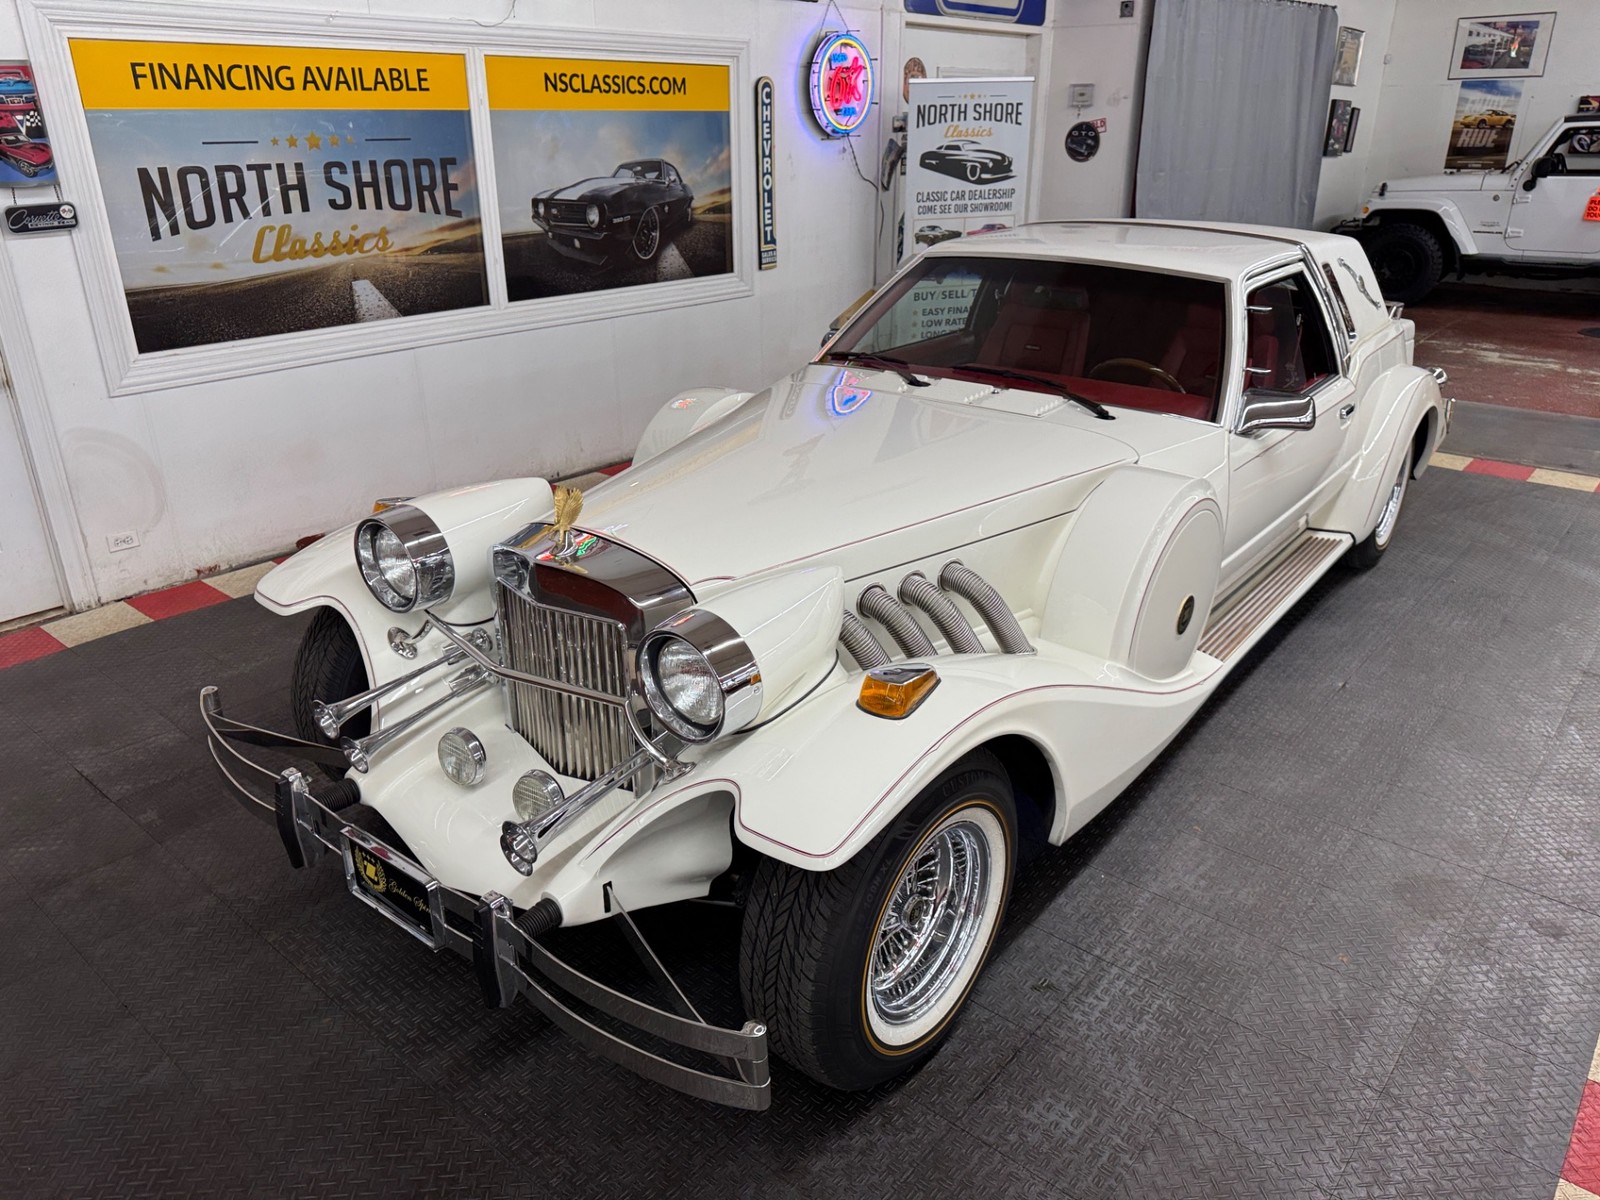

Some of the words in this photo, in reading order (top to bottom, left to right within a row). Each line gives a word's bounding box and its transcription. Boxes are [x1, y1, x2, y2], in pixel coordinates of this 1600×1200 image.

[130, 62, 295, 91] FINANCING
[302, 66, 430, 92] AVAILABLE
[544, 72, 687, 96] NSCLASSICS.COM
[916, 103, 968, 129] NORTH
[973, 102, 1023, 126] SHORE
[944, 124, 993, 138] Classics
[1456, 128, 1498, 148] RIDE
[762, 87, 773, 241] CHEVROLET
[137, 162, 310, 242] NORTH
[323, 157, 463, 218] SHORE
[916, 191, 948, 203] CLASSIC
[950, 189, 966, 202] CAR
[968, 188, 1016, 201] DEALERSHIP
[9, 208, 63, 229] Corvette
[917, 204, 938, 215] COME
[939, 203, 953, 214] SEE
[954, 202, 968, 214] OUR
[970, 201, 1012, 213] SHOWROOM!
[252, 223, 394, 264] Classics
[921, 307, 945, 316] EASY
[921, 319, 943, 328] LOW
